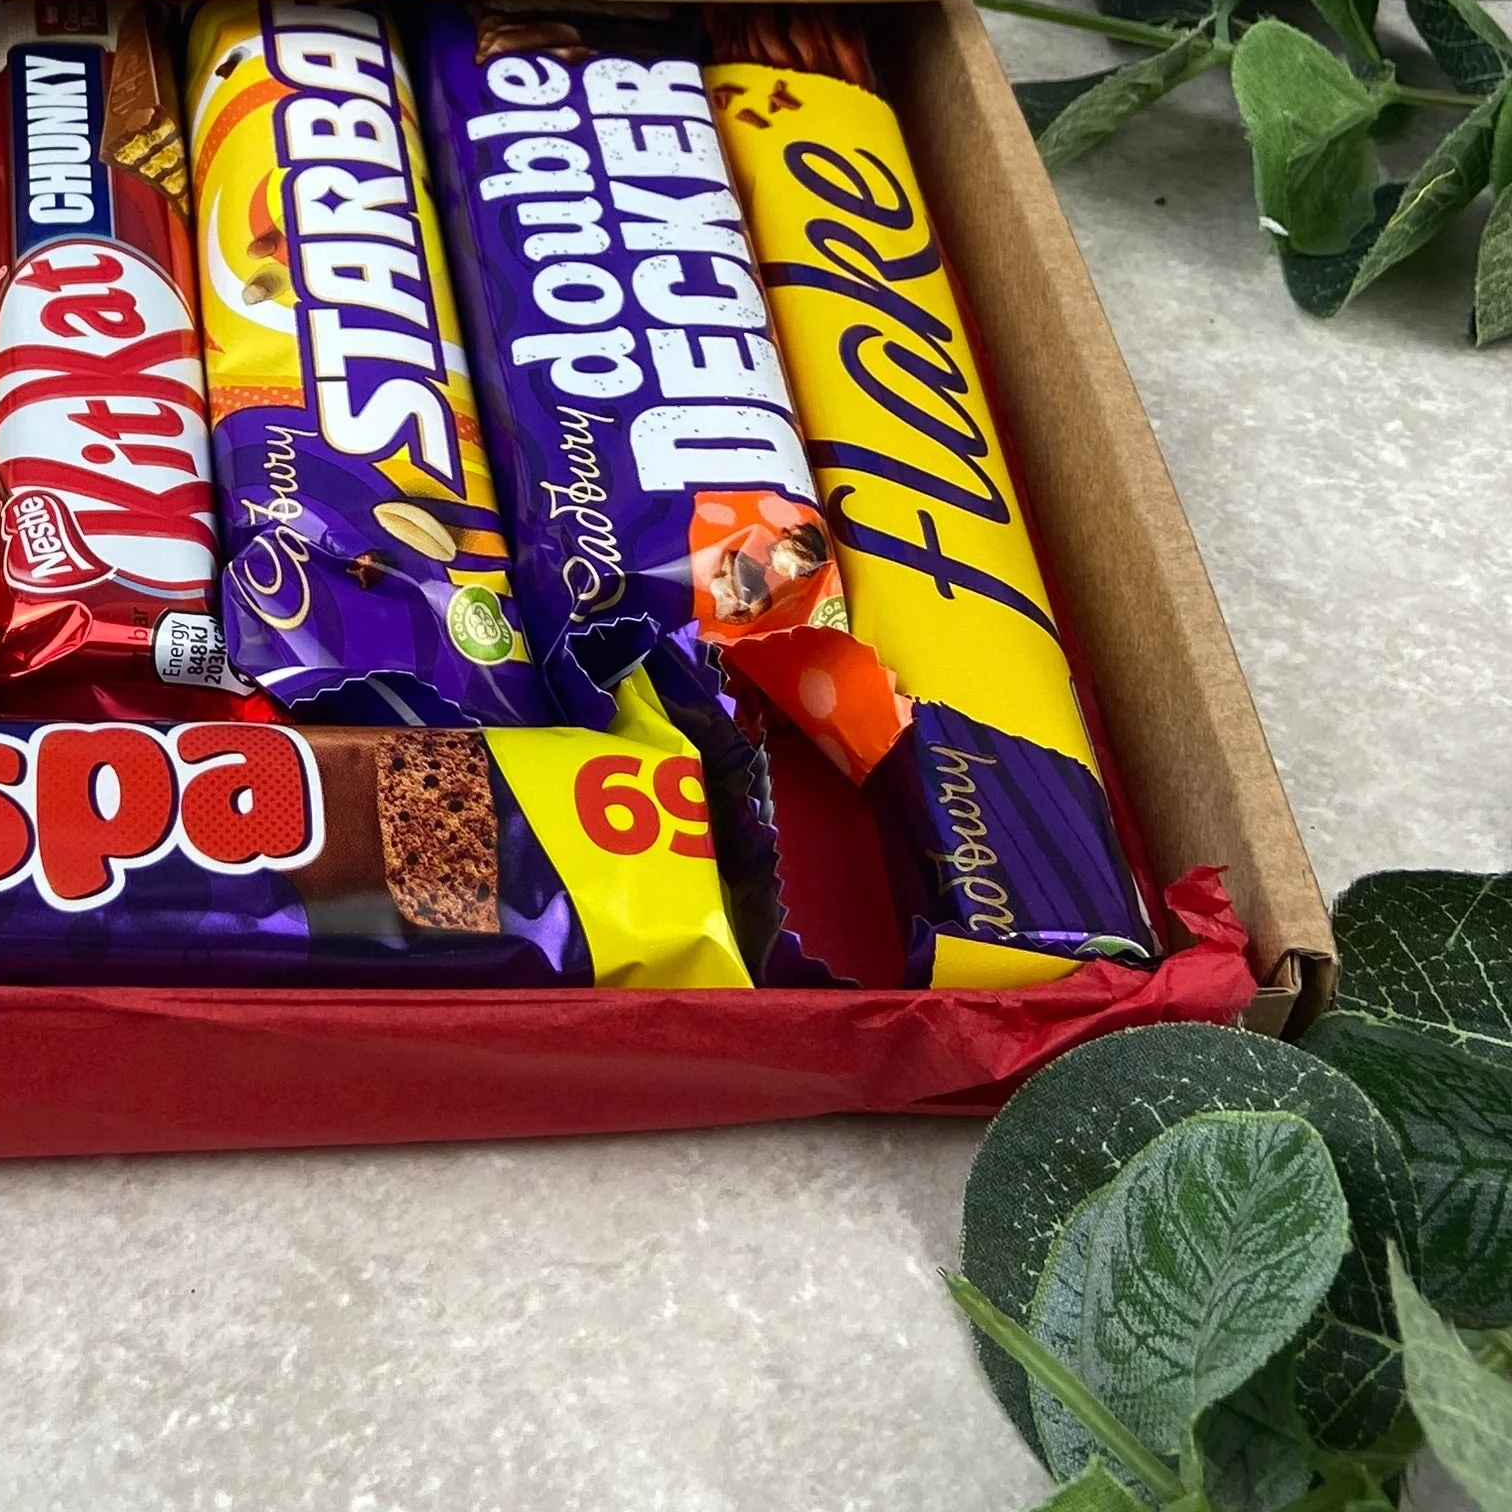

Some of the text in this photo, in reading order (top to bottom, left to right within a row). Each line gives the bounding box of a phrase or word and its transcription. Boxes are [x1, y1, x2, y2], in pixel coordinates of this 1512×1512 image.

[25, 54, 95, 225] CHUNKY
[466, 55, 645, 400] double
[582, 56, 817, 498] DECKER
[228, 424, 319, 630] Cabury
[539, 405, 626, 624] Cadbury
[128, 606, 149, 642] bar
[163, 620, 190, 677] Energy
[187, 625, 208, 675] 848kJ
[924, 744, 1017, 940] adbury
